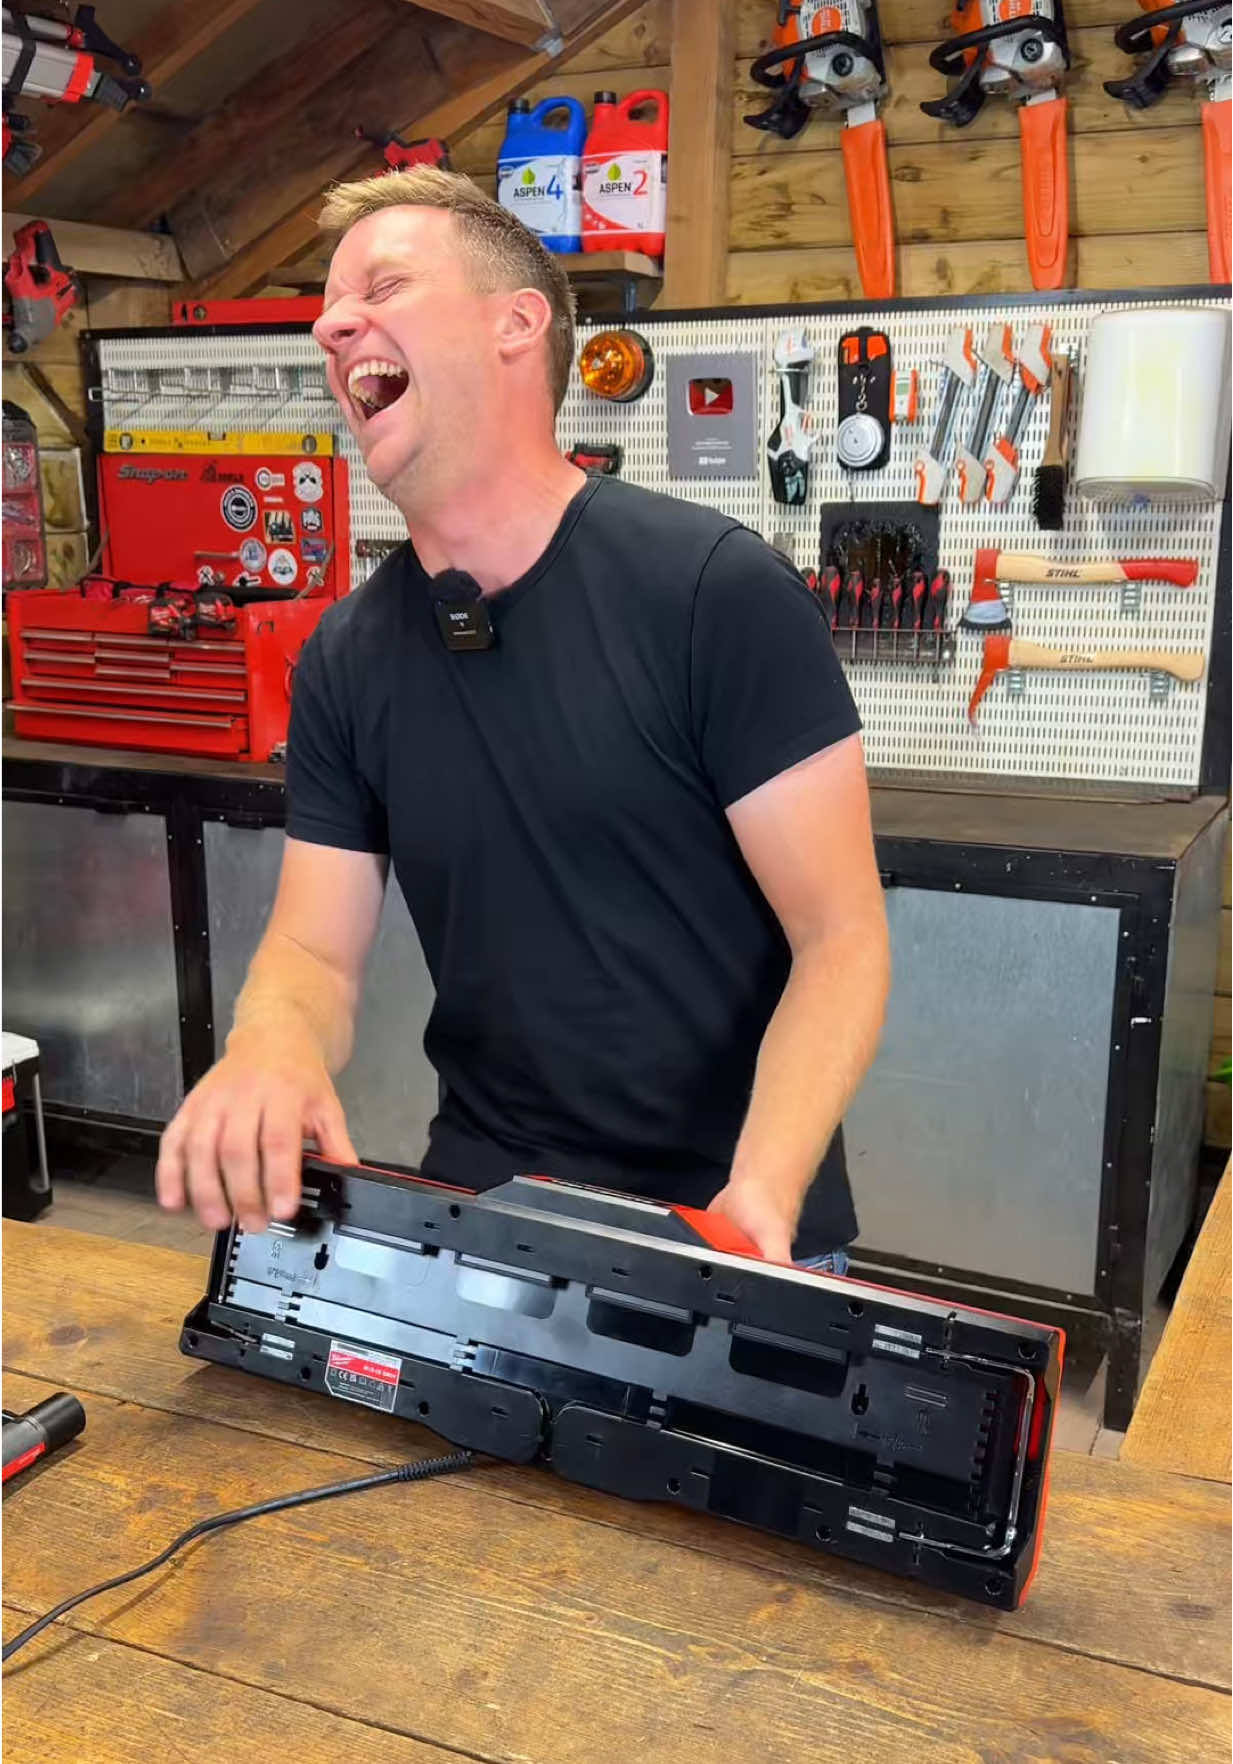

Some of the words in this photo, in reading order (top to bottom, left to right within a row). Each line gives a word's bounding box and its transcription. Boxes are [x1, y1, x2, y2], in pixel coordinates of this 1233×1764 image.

[513, 186, 545, 199] ASPEN
[546, 175, 564, 201] 4
[600, 182, 632, 194] ASPEN
[632, 169, 648, 196] 2
[1046, 568, 1080, 578] STIHL
[1060, 654, 1093, 664] STIHL
